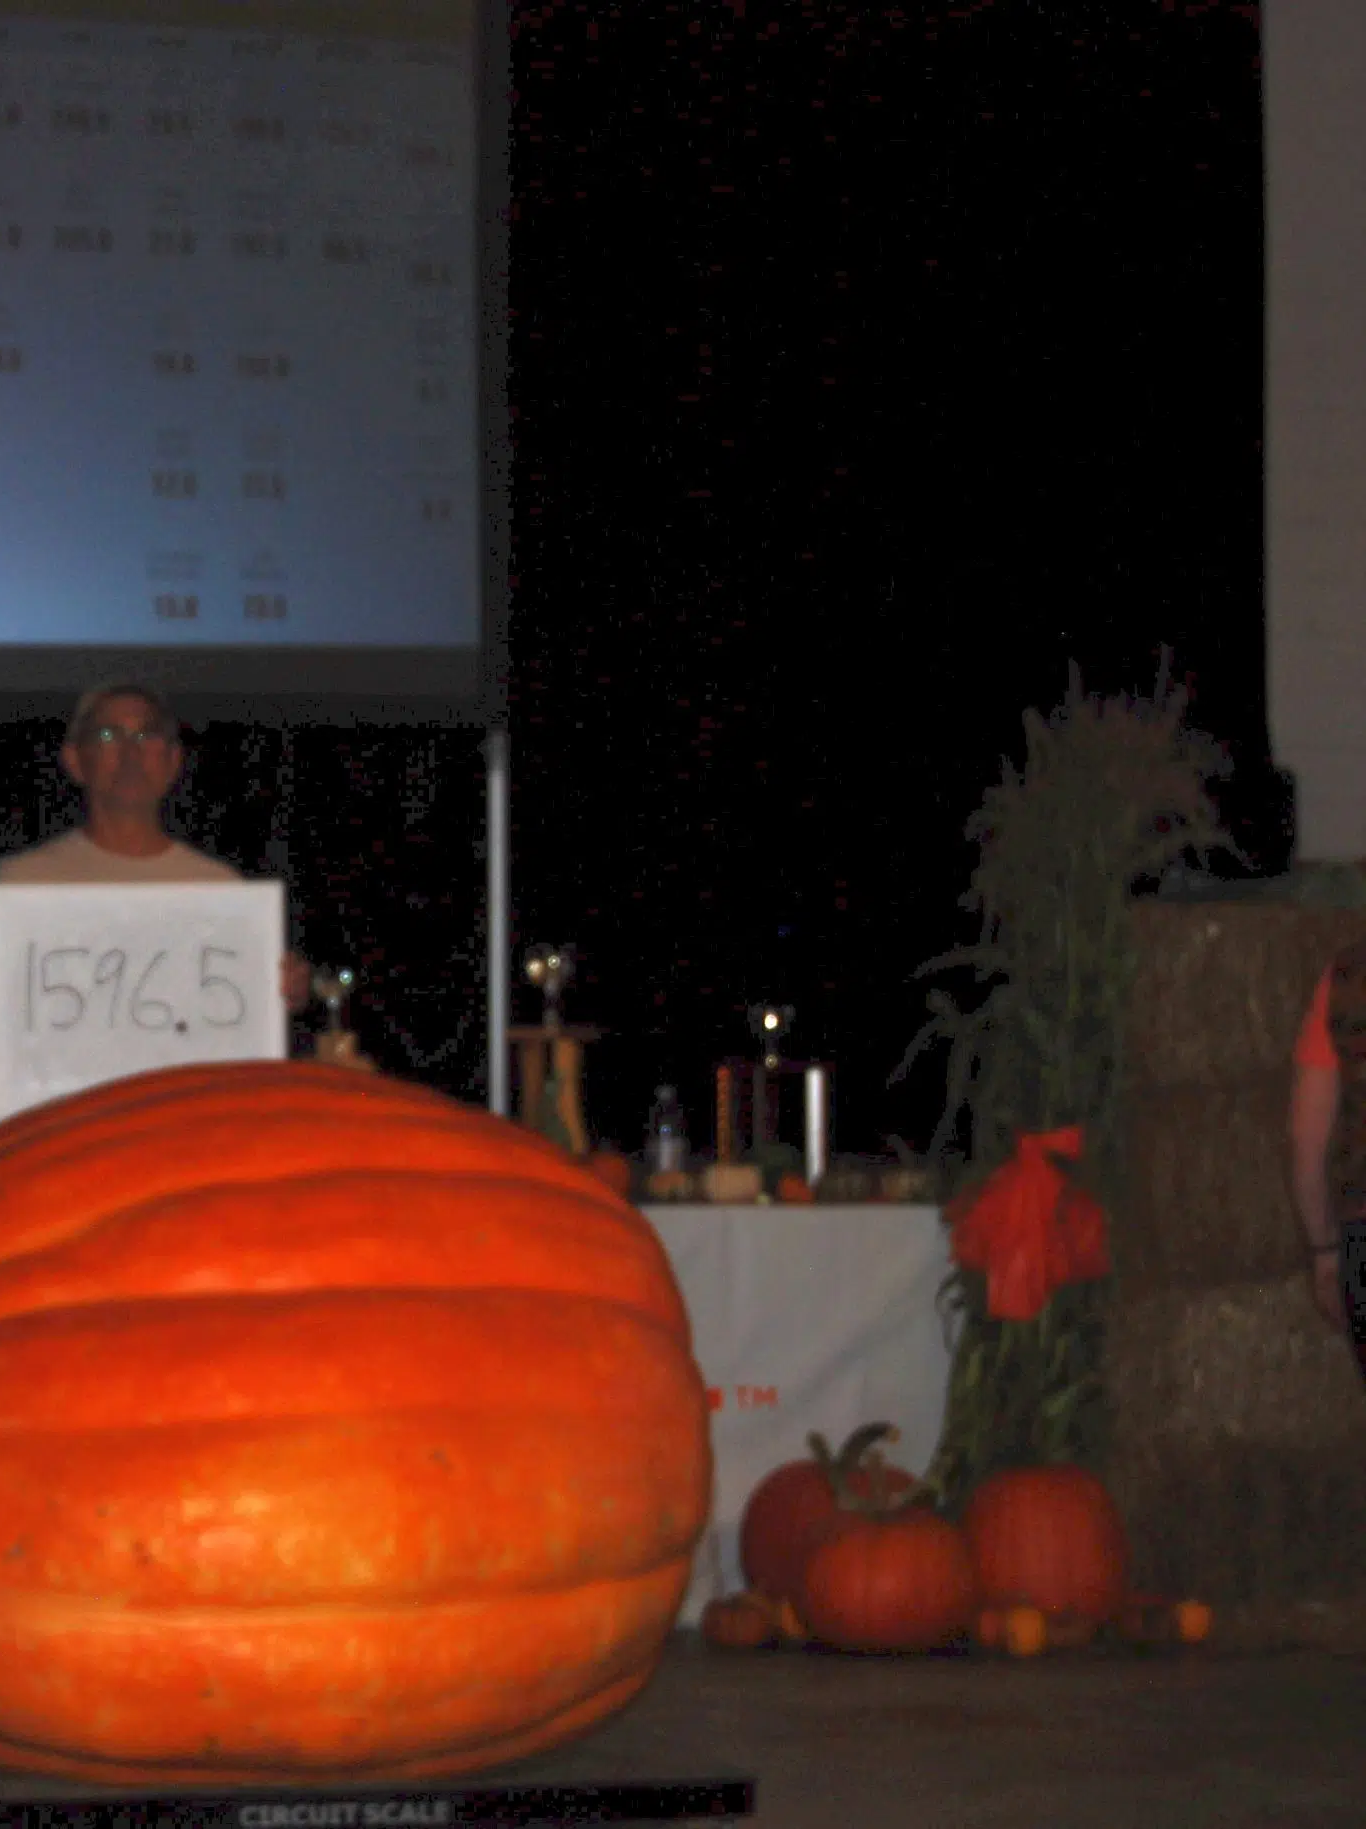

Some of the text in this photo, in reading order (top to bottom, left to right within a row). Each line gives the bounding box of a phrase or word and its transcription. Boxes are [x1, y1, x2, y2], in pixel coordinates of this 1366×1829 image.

[24, 942, 246, 1033] 1596.5
[239, 1800, 451, 1828] CIRCUIT SCALE
